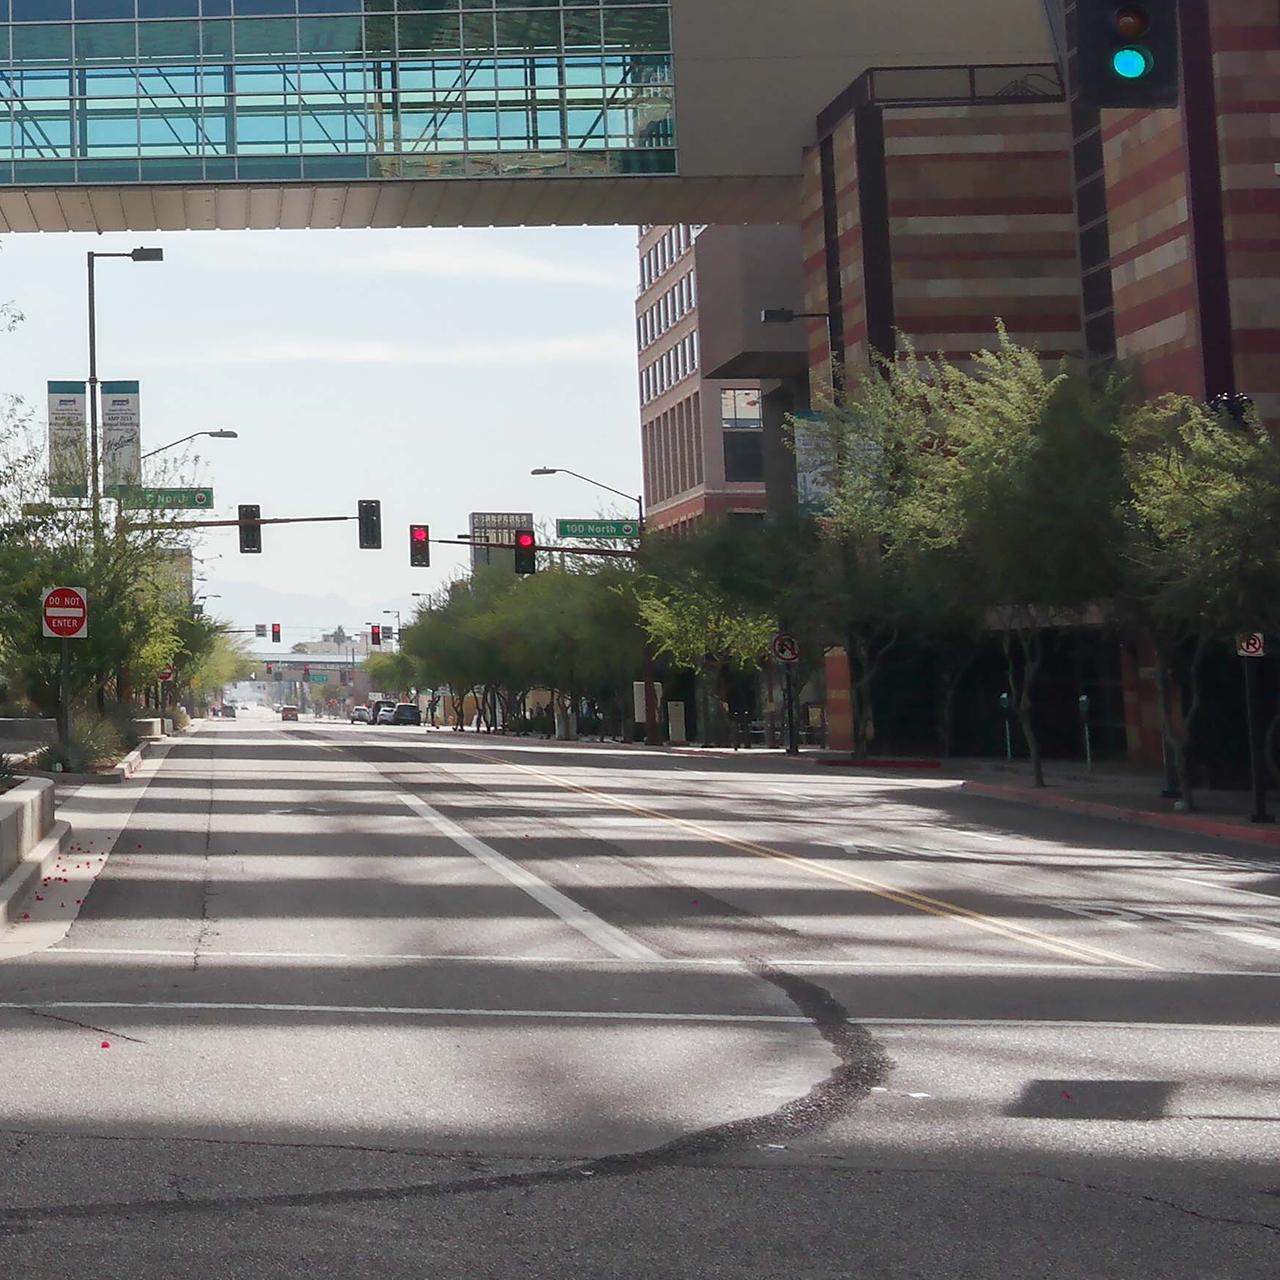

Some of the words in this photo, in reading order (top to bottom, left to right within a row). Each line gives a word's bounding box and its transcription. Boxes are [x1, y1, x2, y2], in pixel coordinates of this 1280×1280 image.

[566, 524, 584, 533] 100
[588, 524, 616, 533] North
[49, 596, 60, 605] DO
[64, 597, 80, 606] NOT
[52, 619, 78, 627] ENTER
